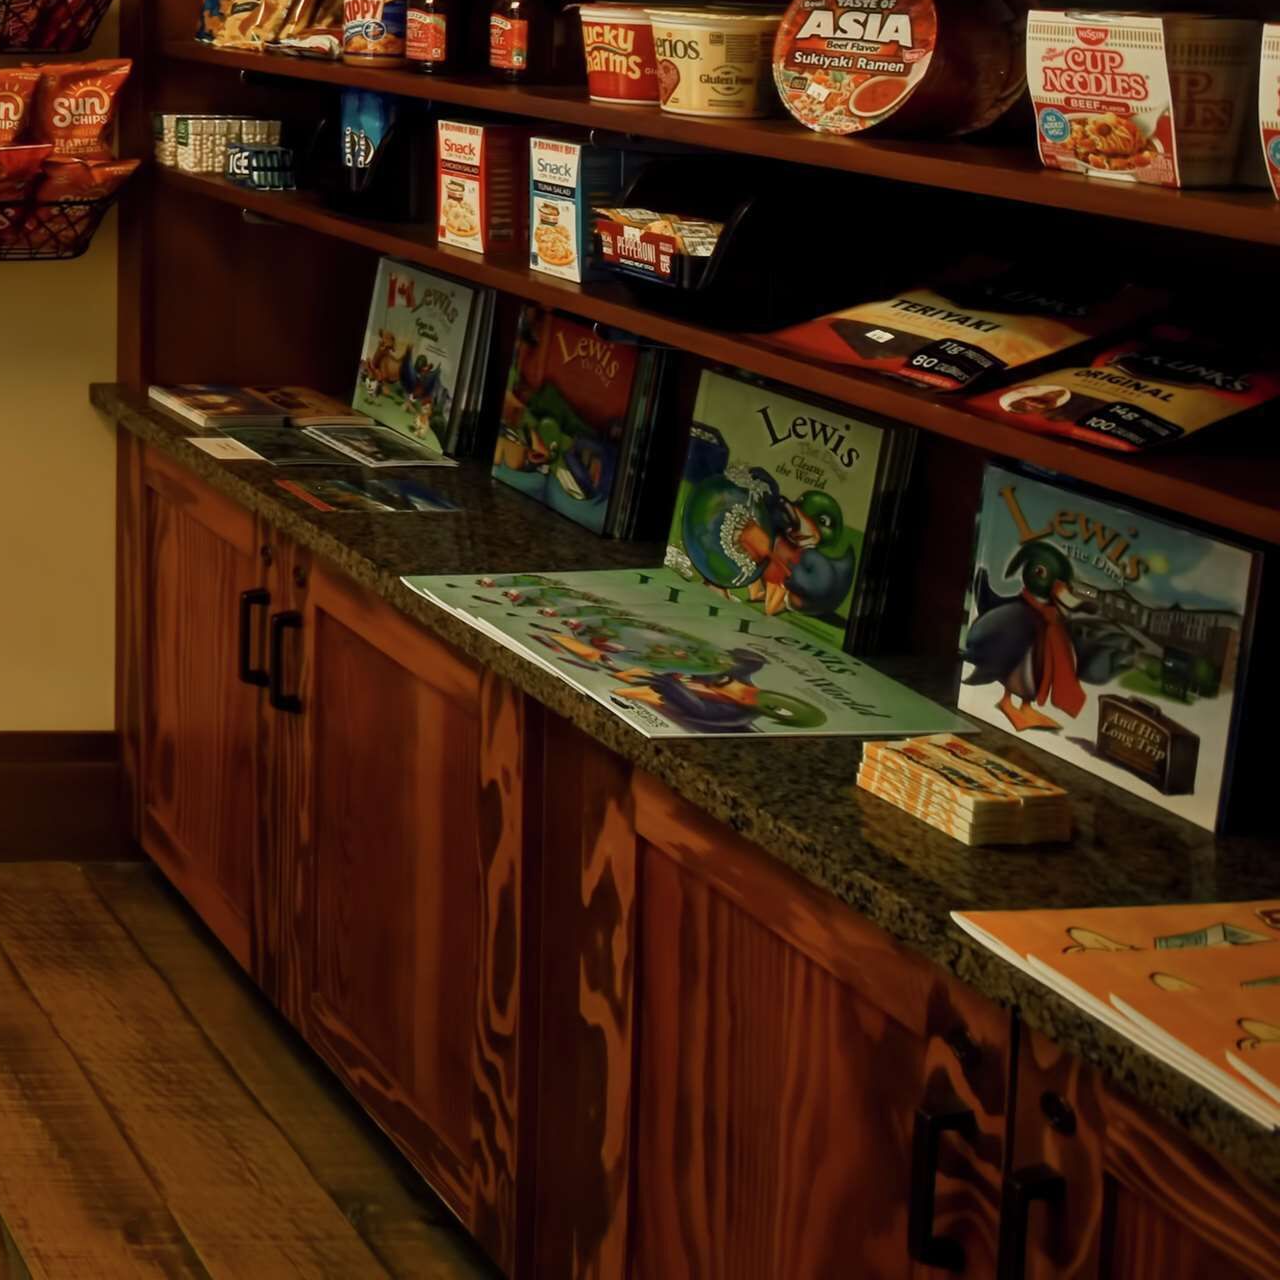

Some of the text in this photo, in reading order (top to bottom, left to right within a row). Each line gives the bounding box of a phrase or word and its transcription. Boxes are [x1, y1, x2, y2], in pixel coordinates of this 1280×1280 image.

[796, 10, 913, 48] ASIA
[1079, 28, 1106, 40] NISSIN
[826, 40, 881, 54] Beef Flavor
[794, 51, 905, 74] Sukiyaki Ramen
[1064, 46, 1124, 73] CUP
[699, 73, 733, 86] Gluten
[1042, 68, 1149, 101] NOODLES
[53, 96, 110, 128] Sun
[1070, 98, 1101, 111] BEEF
[72, 114, 108, 125] CHIPS
[444, 138, 476, 157] Snack
[537, 158, 571, 178] Snack
[537, 182, 571, 197] TUNA SALAD
[616, 234, 657, 264] PEPPERONI
[890, 298, 1002, 334] TERIYAKI
[556, 329, 620, 379] Lewis
[941, 341, 963, 356] 11g
[911, 353, 938, 370] 80
[1072, 366, 1175, 404] ORIGINAL
[1085, 416, 1114, 432] 100
[756, 405, 861, 469] Lewis
[795, 470, 827, 491] World
[998, 485, 1149, 582] Lewis
[1061, 543, 1088, 562] The
[738, 618, 860, 677] Lewis
[1111, 711, 1163, 743] And His
[1101, 723, 1167, 762] Long Trip
